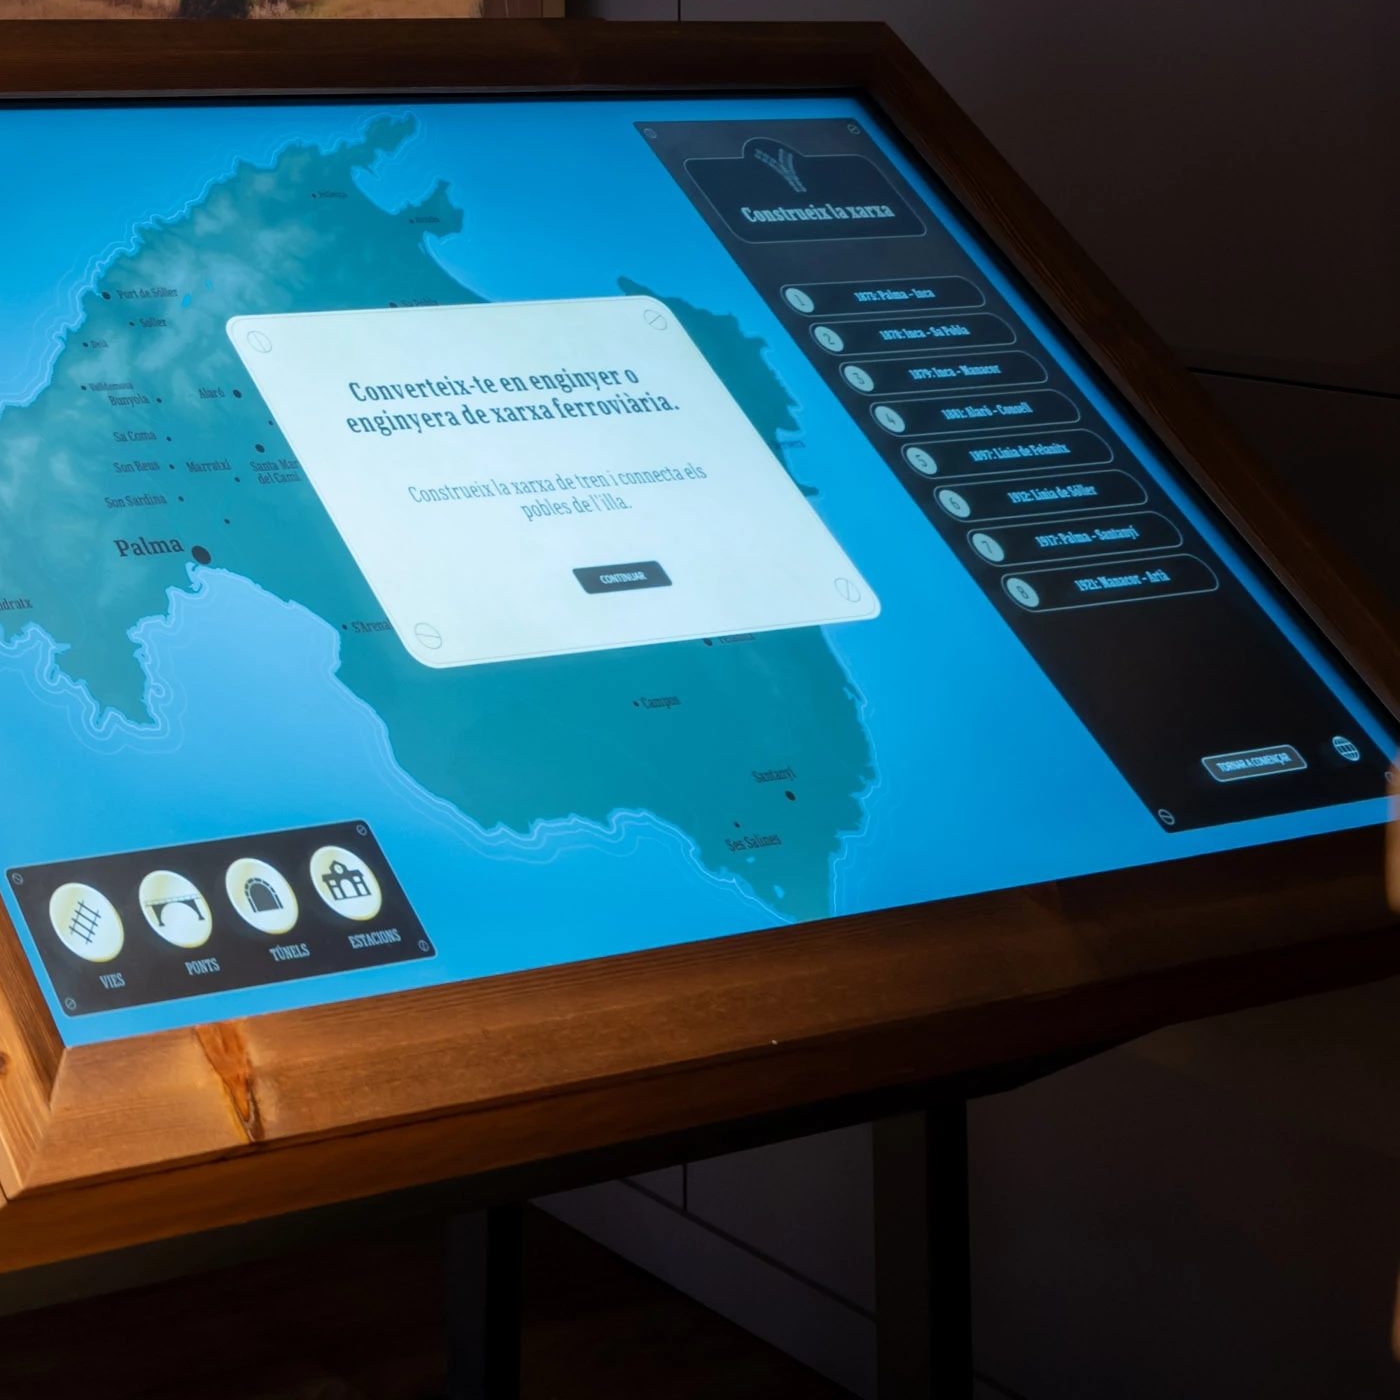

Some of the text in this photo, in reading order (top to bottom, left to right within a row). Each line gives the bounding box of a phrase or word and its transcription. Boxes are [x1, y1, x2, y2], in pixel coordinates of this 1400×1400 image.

[741, 203, 896, 222] Construeix la xarxa
[116, 289, 140, 299] Port
[877, 289, 910, 300] Palma
[911, 288, 936, 299] Inca
[902, 328, 927, 339] Inca
[929, 327, 945, 337] Sa
[941, 324, 971, 336] Pobla
[931, 367, 957, 378] Inca
[958, 365, 1002, 376] Manacor
[349, 368, 640, 403] Converteix-te en enginyer o
[108, 393, 150, 407] Bunyola
[346, 393, 680, 436] enginyera de xarxa ferroviària.
[996, 401, 1034, 415] Consell
[113, 430, 157, 442] Sa Coma
[1017, 445, 1033, 456] de
[1028, 442, 1071, 456] Felanitx
[113, 462, 133, 473] Son
[250, 461, 281, 472] Santa
[257, 473, 274, 485] del
[407, 462, 708, 504] Construeix la xarxa de tren i connecta els
[1055, 486, 1070, 498] de
[1067, 484, 1098, 497] Sóller
[104, 494, 167, 509] Son Sardina
[520, 498, 573, 522] pobles
[572, 496, 594, 515] de
[1058, 531, 1092, 544] Palma
[113, 536, 185, 557] Palma
[598, 570, 648, 585] CONTINUAR
[1097, 575, 1142, 588] Manacor
[640, 696, 681, 709] Campos
[1216, 759, 1249, 772] TORNAR
[724, 834, 782, 852] Ses Salines
[347, 928, 402, 950] ESTACIONS
[269, 942, 311, 963] TÚNELS
[184, 958, 220, 976] PONTS
[99, 973, 126, 990] VIES
